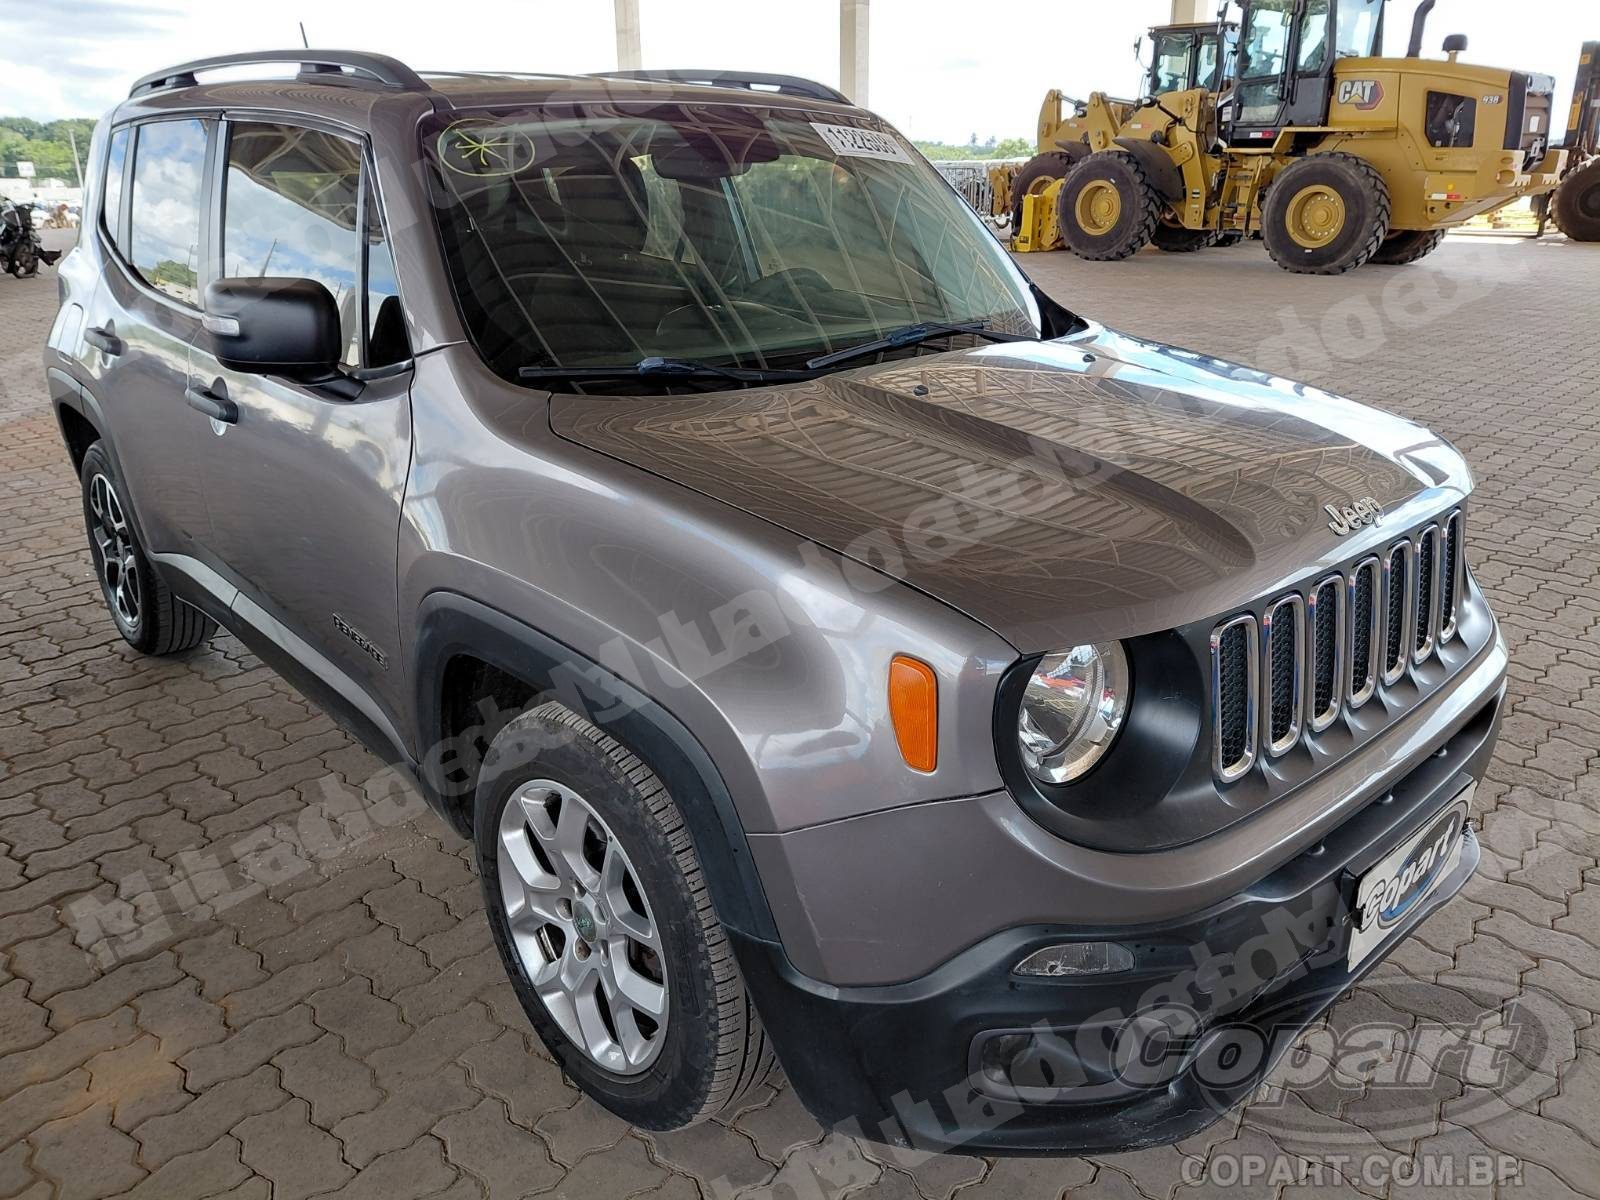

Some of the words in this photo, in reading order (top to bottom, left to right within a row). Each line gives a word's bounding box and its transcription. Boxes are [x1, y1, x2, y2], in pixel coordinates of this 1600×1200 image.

[1338, 80, 1375, 104] CAT
[1482, 95, 1500, 104] 938
[1324, 496, 1385, 536] Jeep
[1361, 816, 1456, 934] Copart
